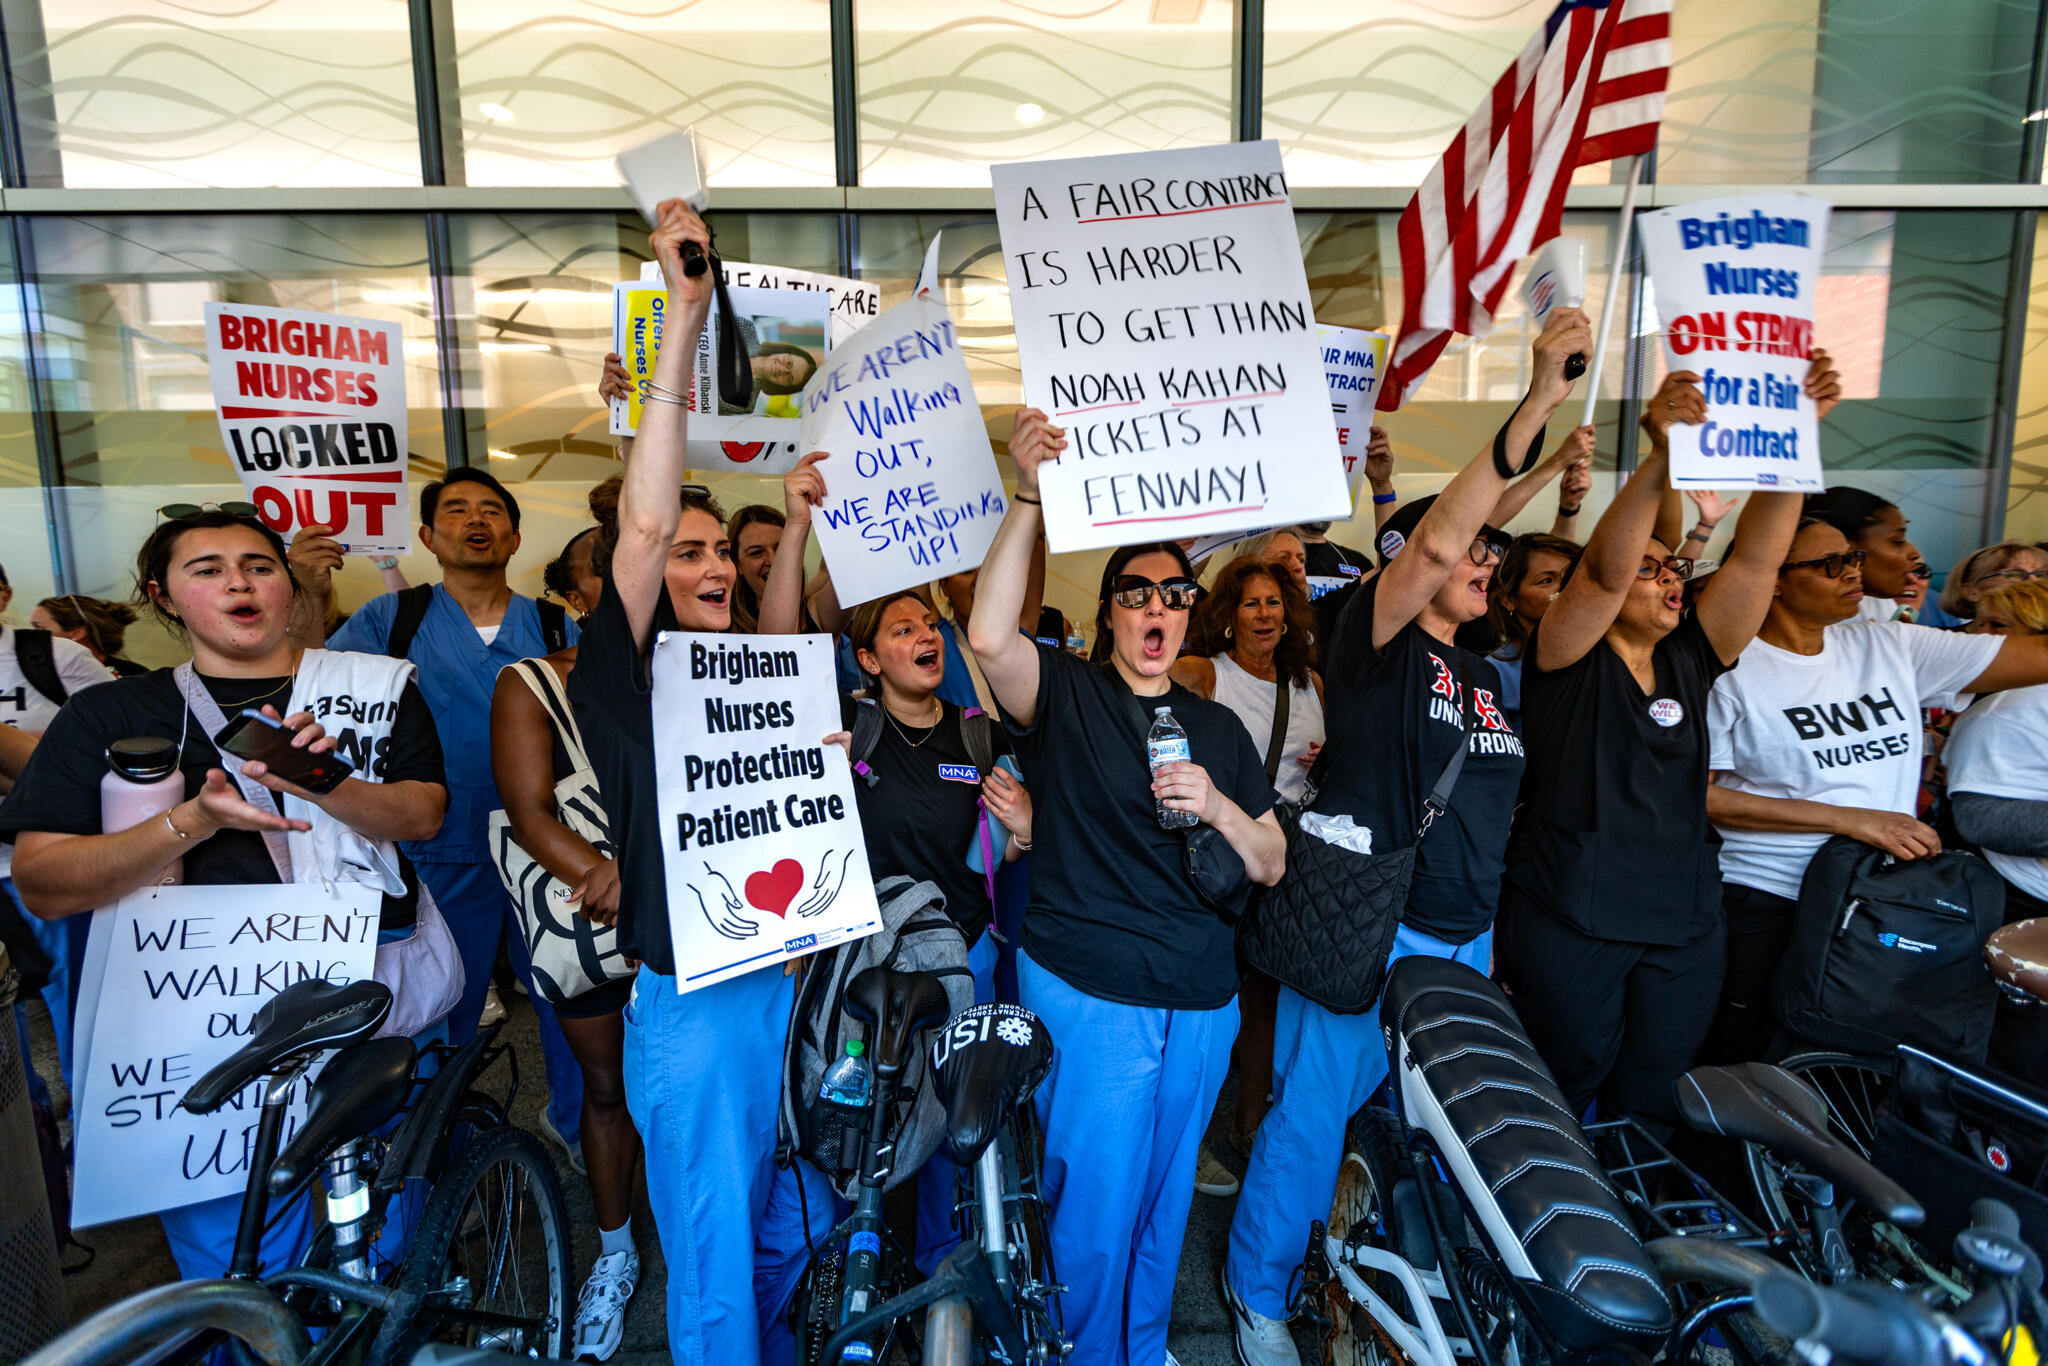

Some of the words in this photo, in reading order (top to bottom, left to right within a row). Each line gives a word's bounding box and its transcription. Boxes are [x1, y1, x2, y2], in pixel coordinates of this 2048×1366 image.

[1022, 187, 1049, 222] A
[1677, 208, 1809, 253] Brigham
[1015, 249, 1068, 290] IS
[1086, 235, 1243, 285] HARDER
[1702, 261, 1798, 300] Nurses
[219, 313, 390, 366] BRIGHAM
[634, 316, 648, 375] Nurses
[698, 335, 710, 350] CEO
[1048, 310, 1105, 349] TO
[1124, 305, 1200, 343] GET
[1205, 299, 1308, 335] THAN
[1668, 311, 1727, 356] ON
[1735, 311, 1815, 361] STRIKE
[698, 351, 710, 374] Anne
[806, 363, 851, 415] WE
[856, 319, 956, 384] AREN'T
[1343, 350, 1375, 369] MNA
[235, 360, 379, 408] NURSES
[700, 375, 712, 414] Klibanski
[1050, 372, 1146, 409] NOAH
[1158, 361, 1287, 400] KAHAN
[1703, 368, 1743, 405] for
[1747, 380, 1761, 407] a
[1764, 373, 1799, 411] Fair
[843, 381, 964, 440] Walking
[1222, 404, 1265, 439] AT
[228, 421, 399, 473] LOCKED
[855, 438, 933, 479] OUT,
[1699, 420, 1798, 461] Contract
[822, 497, 870, 532] WE
[884, 482, 941, 517] ARE
[1084, 460, 1270, 516] FENWAY!
[251, 484, 397, 538] OUT
[861, 488, 1005, 553] STANDING
[909, 534, 962, 568] UP!
[690, 641, 800, 685] Brigham
[705, 698, 795, 735] Nurses
[1651, 709, 1682, 718] WILL
[1656, 702, 1678, 710] WE
[1782, 685, 1907, 741] BWH
[684, 742, 826, 793] Protecting
[942, 767, 975, 779] MNA
[1811, 732, 1911, 771] NURSES
[677, 803, 781, 852] Patient
[784, 792, 845, 830] Care
[132, 916, 217, 952] WE
[228, 907, 379, 945] AREN'T
[786, 936, 814, 951] MNA
[110, 1053, 193, 1087] WE
